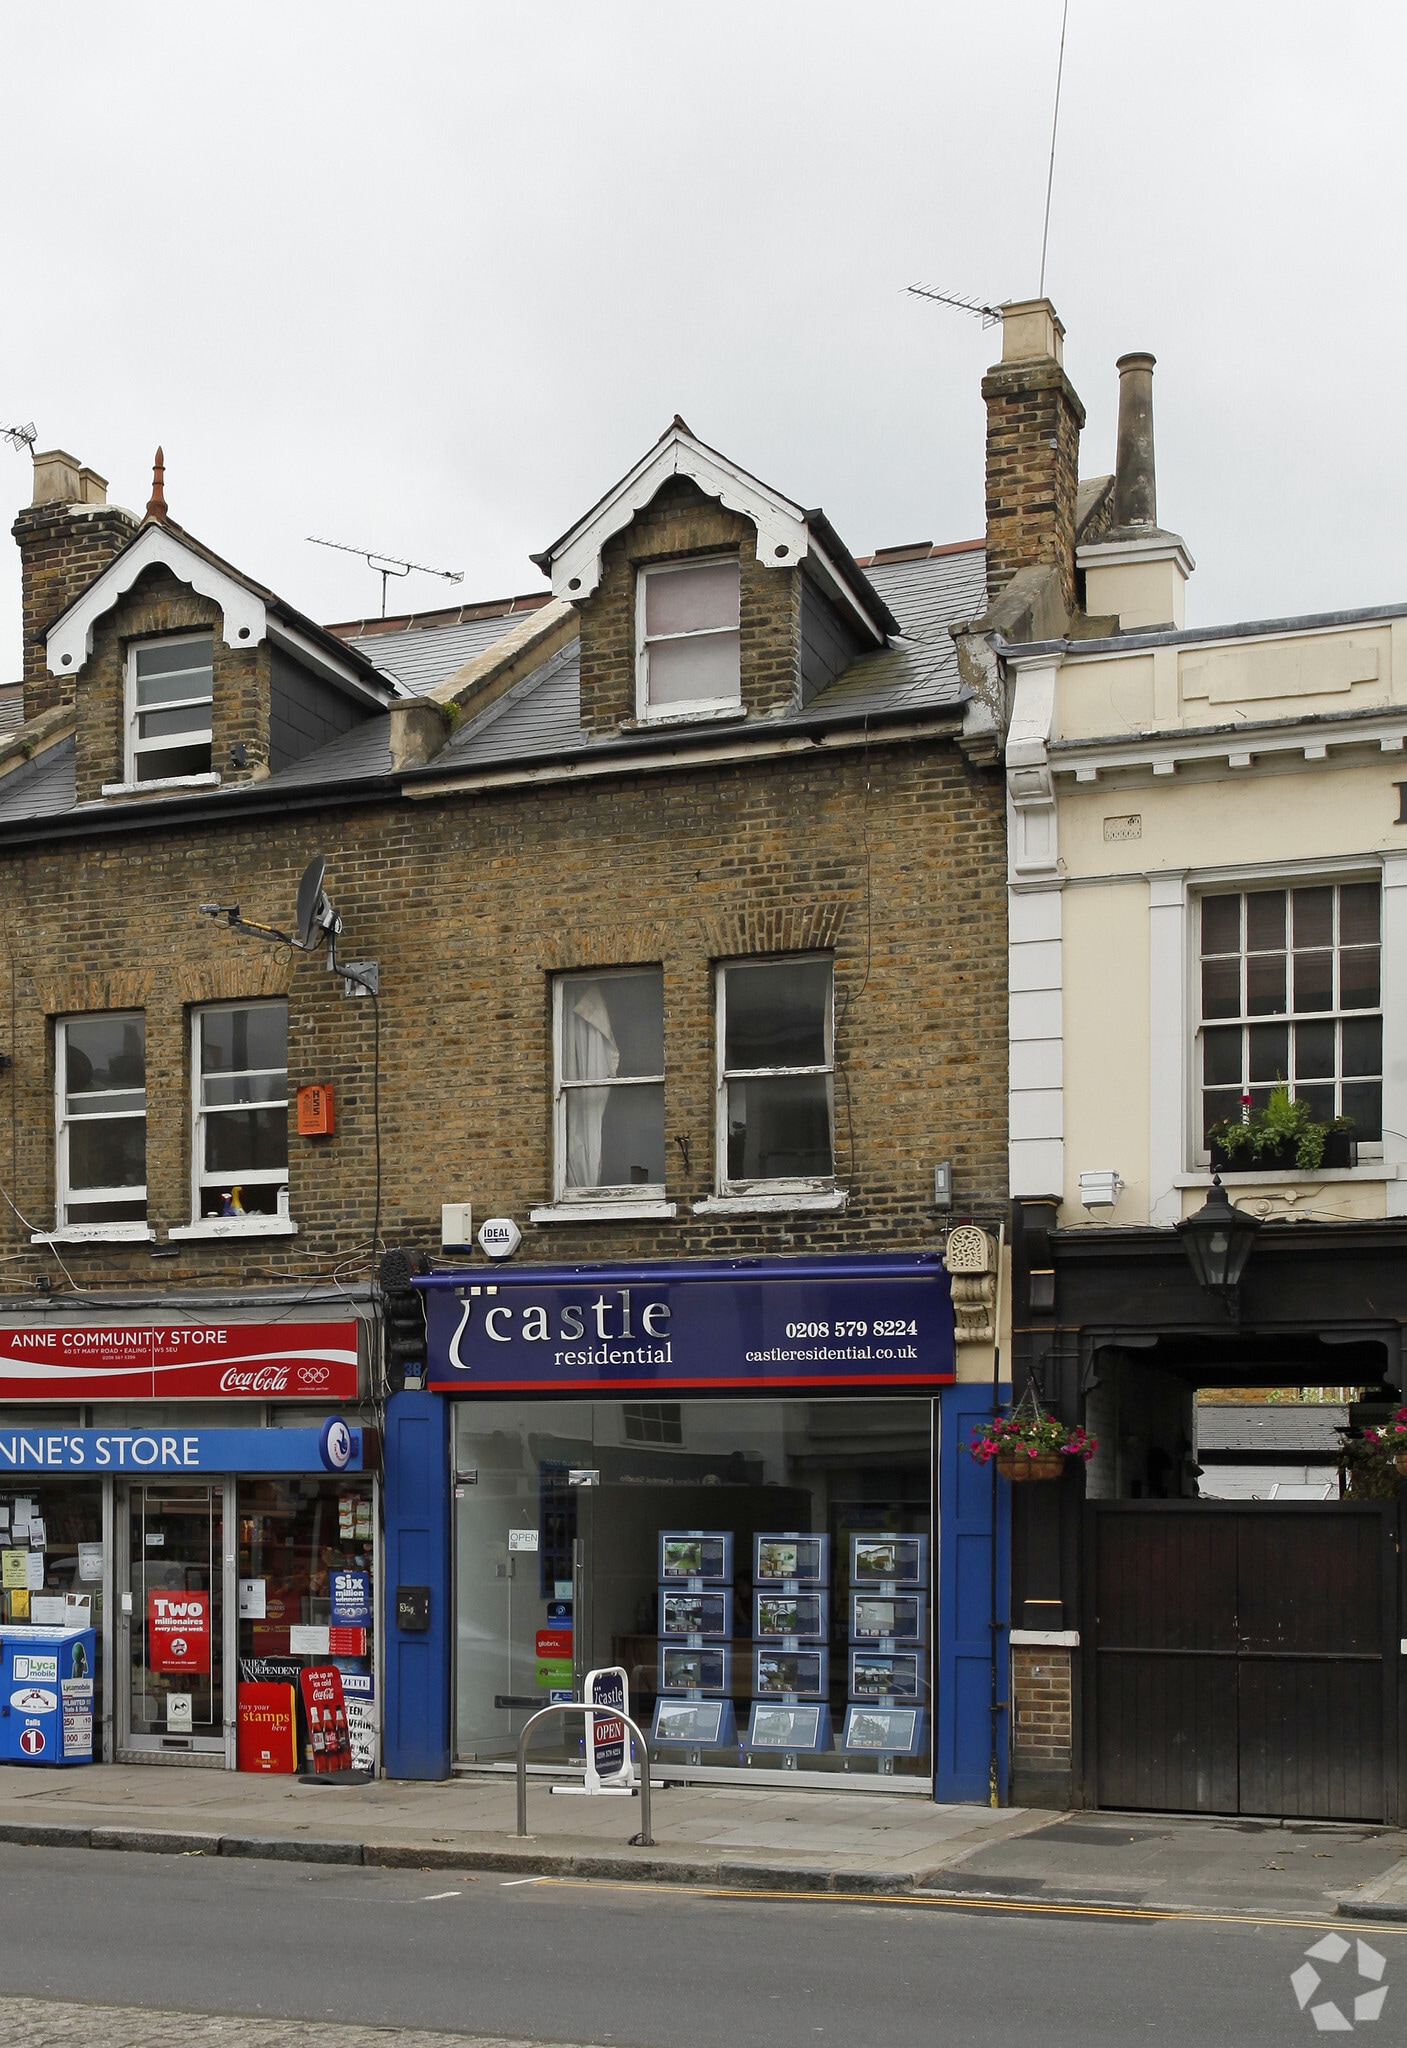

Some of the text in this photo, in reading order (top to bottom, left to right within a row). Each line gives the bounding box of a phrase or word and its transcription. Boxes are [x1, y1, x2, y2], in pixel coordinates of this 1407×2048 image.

[485, 1289, 671, 1342] castle
[785, 1319, 918, 1339] 0208 579 8224
[11, 1330, 227, 1348] ANNE COMMUNITY STORE
[554, 1341, 673, 1366] residential
[745, 1345, 918, 1362] castleresidential.co.uk
[404, 1362, 421, 1377] 38
[219, 1366, 291, 1392] Coca-Cola
[95, 1435, 200, 1465] STORE
[510, 1532, 538, 1542] OPEN
[334, 1574, 363, 1590] Six
[335, 1589, 364, 1597] million
[154, 1599, 203, 1617] Two
[154, 1617, 203, 1625] millionaires
[30, 1659, 56, 1671] Lyca
[30, 1669, 56, 1678] mobile
[308, 1672, 319, 1681] pick
[320, 1672, 327, 1680] up
[63, 1683, 91, 1692] Lycamobile
[598, 1686, 623, 1705] castle
[239, 1702, 270, 1712] buy your
[25, 1718, 41, 1726] Calls
[243, 1711, 290, 1726] stamps
[271, 1723, 287, 1732] here
[596, 1722, 622, 1741] OPEN
